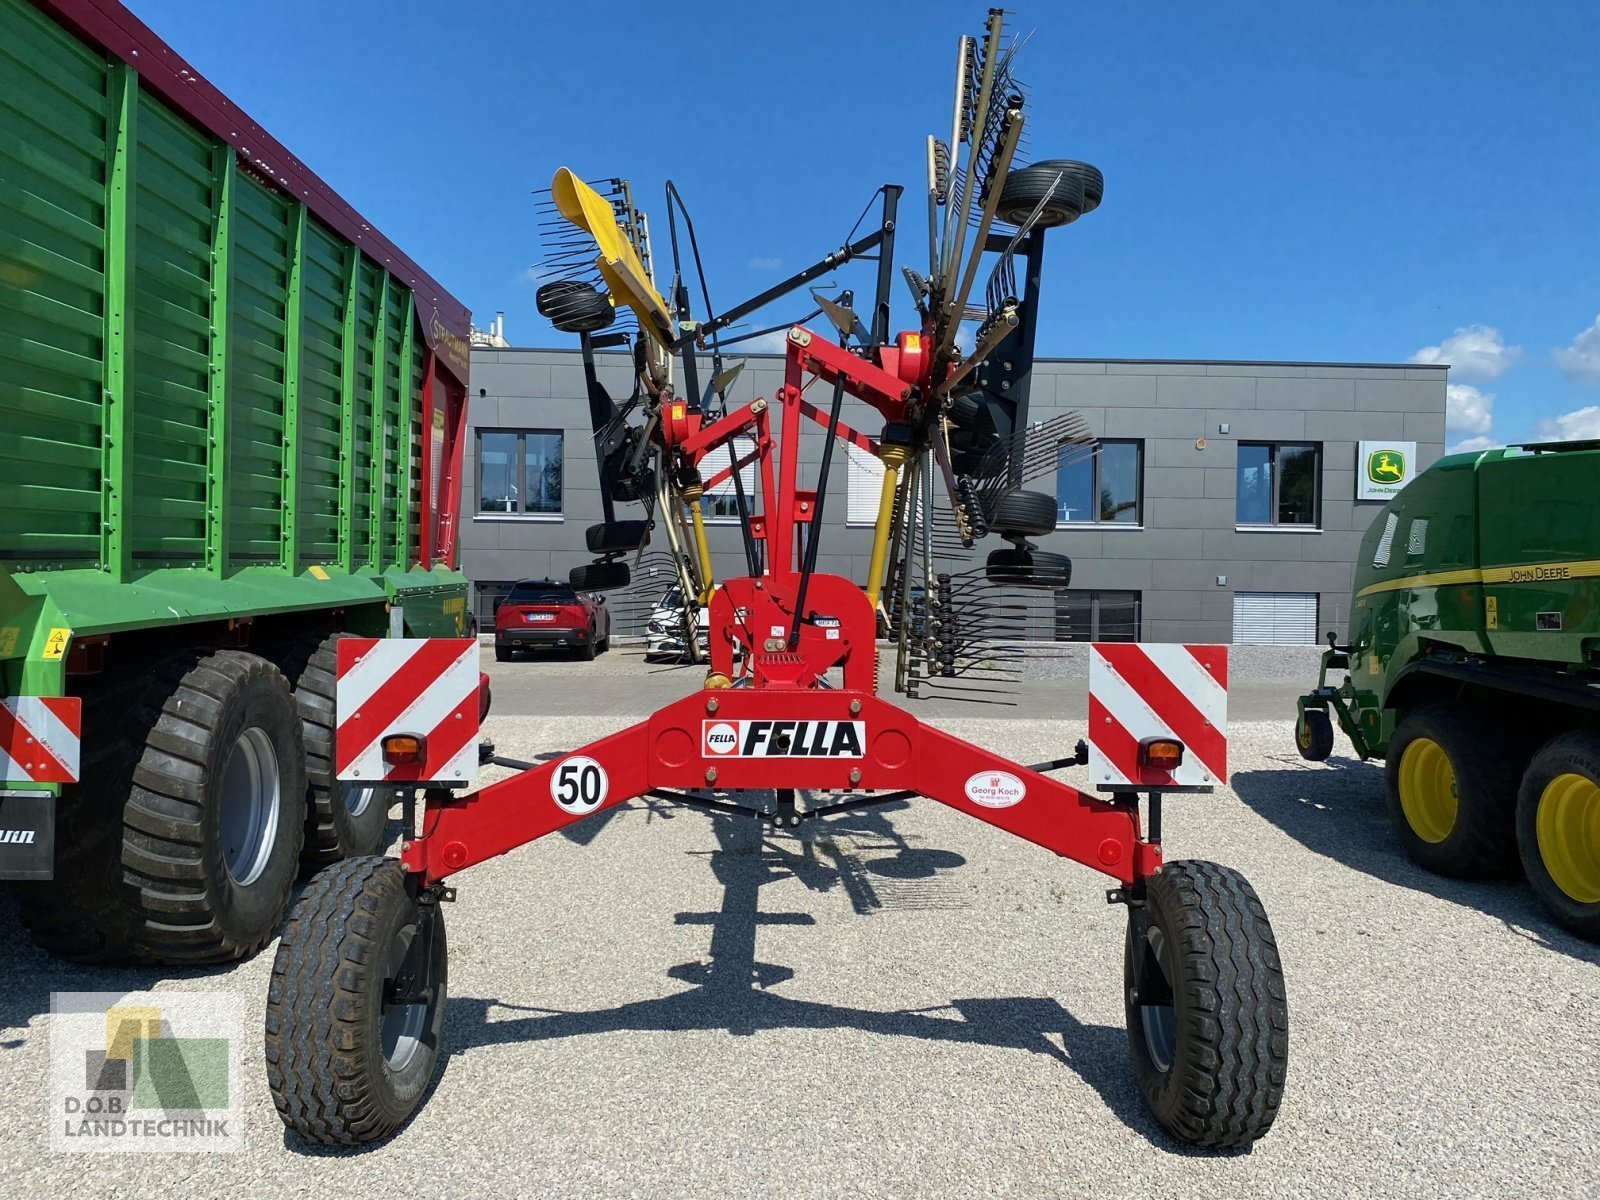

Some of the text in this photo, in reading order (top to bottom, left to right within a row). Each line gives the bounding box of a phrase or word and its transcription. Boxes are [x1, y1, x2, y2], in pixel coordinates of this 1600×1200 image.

[1509, 567, 1570, 581] JOHN DEERE
[708, 734, 736, 743] FELLA
[742, 721, 862, 756] FELLA
[557, 765, 601, 805] 50
[971, 786, 1019, 796] Georg Koch
